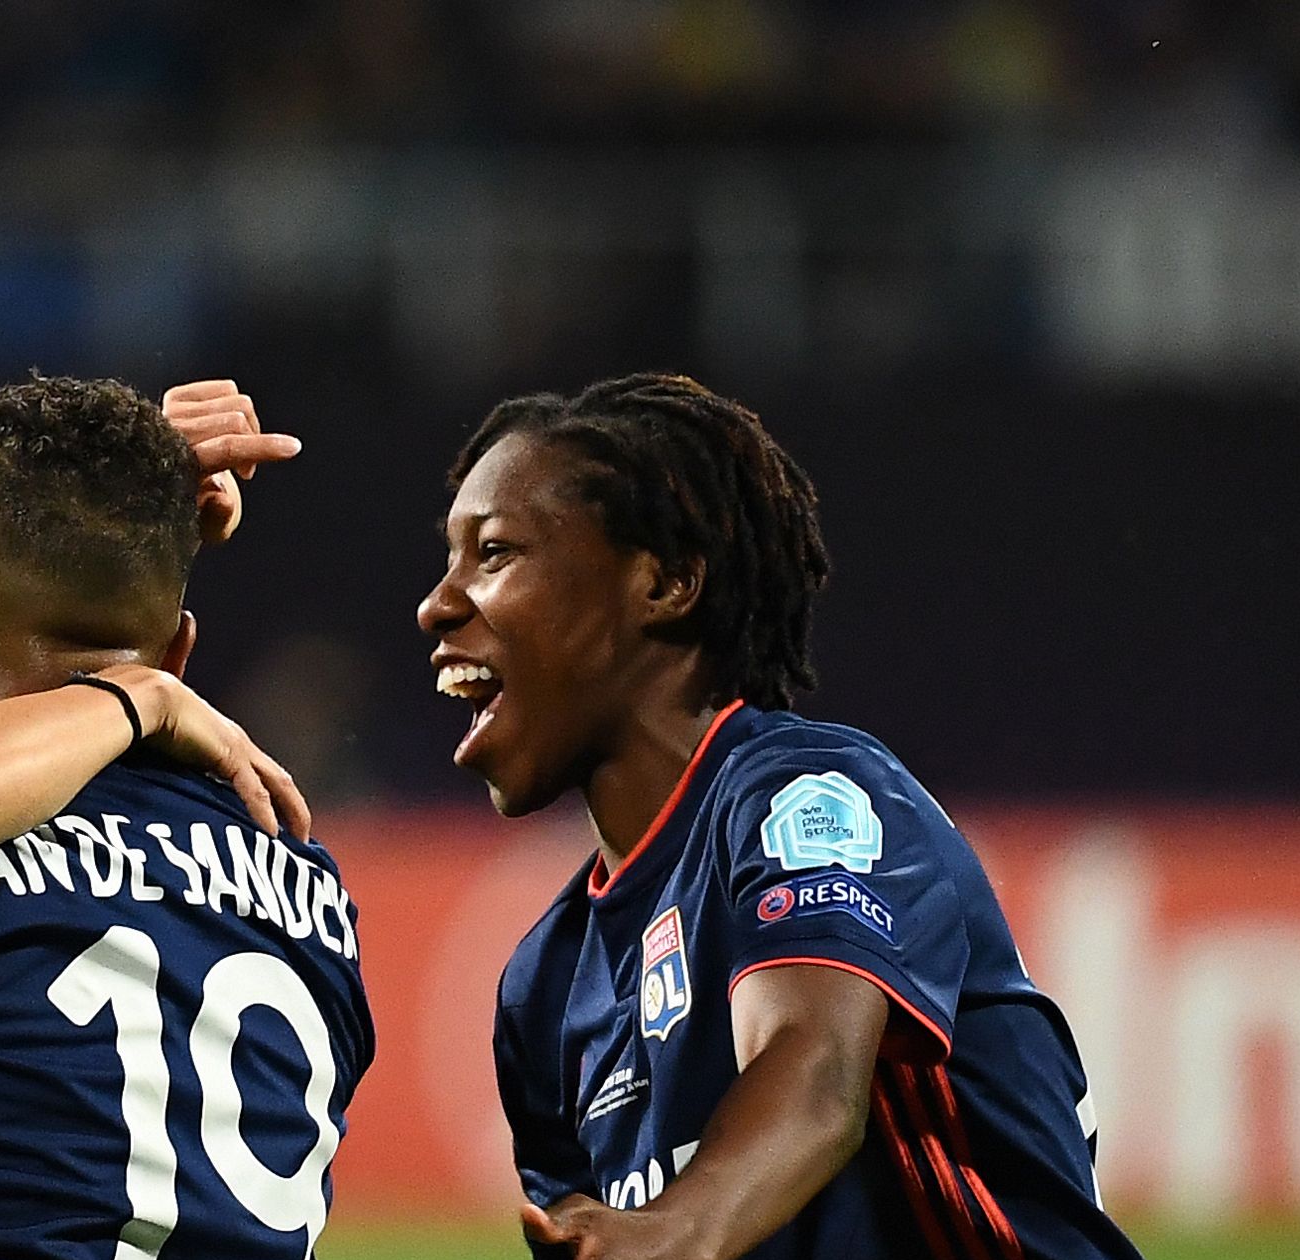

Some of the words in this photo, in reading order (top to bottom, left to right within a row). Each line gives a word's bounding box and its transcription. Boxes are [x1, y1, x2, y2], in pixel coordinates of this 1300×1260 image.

[800, 805, 822, 815] We
[802, 816, 834, 828] play
[55, 813, 164, 901] DE
[799, 882, 894, 932] RESPECT
